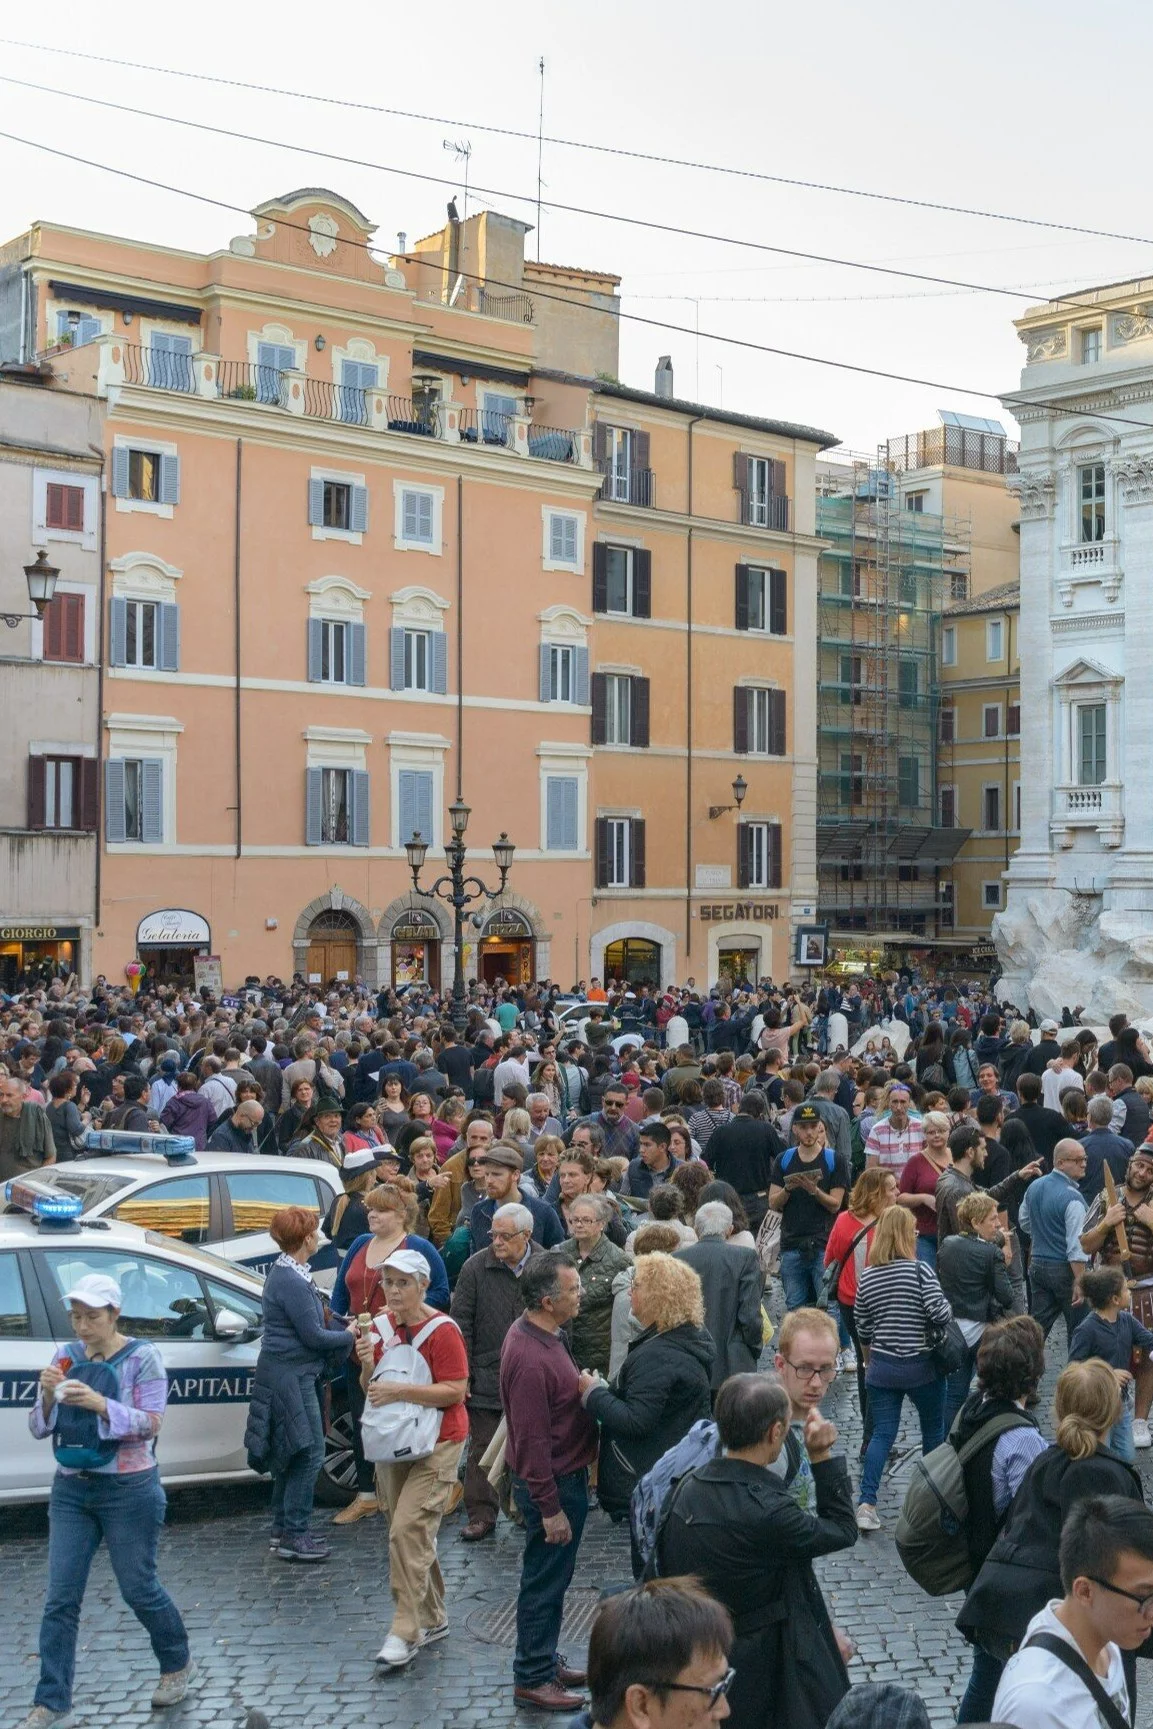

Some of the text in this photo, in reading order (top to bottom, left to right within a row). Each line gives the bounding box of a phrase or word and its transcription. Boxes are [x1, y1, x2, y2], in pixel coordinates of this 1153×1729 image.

[700, 903, 778, 920] SEGATORI
[1, 928, 56, 938] GIORGIO
[142, 927, 200, 940] Gelateria
[0, 1376, 255, 1400] LIZI APITALE
